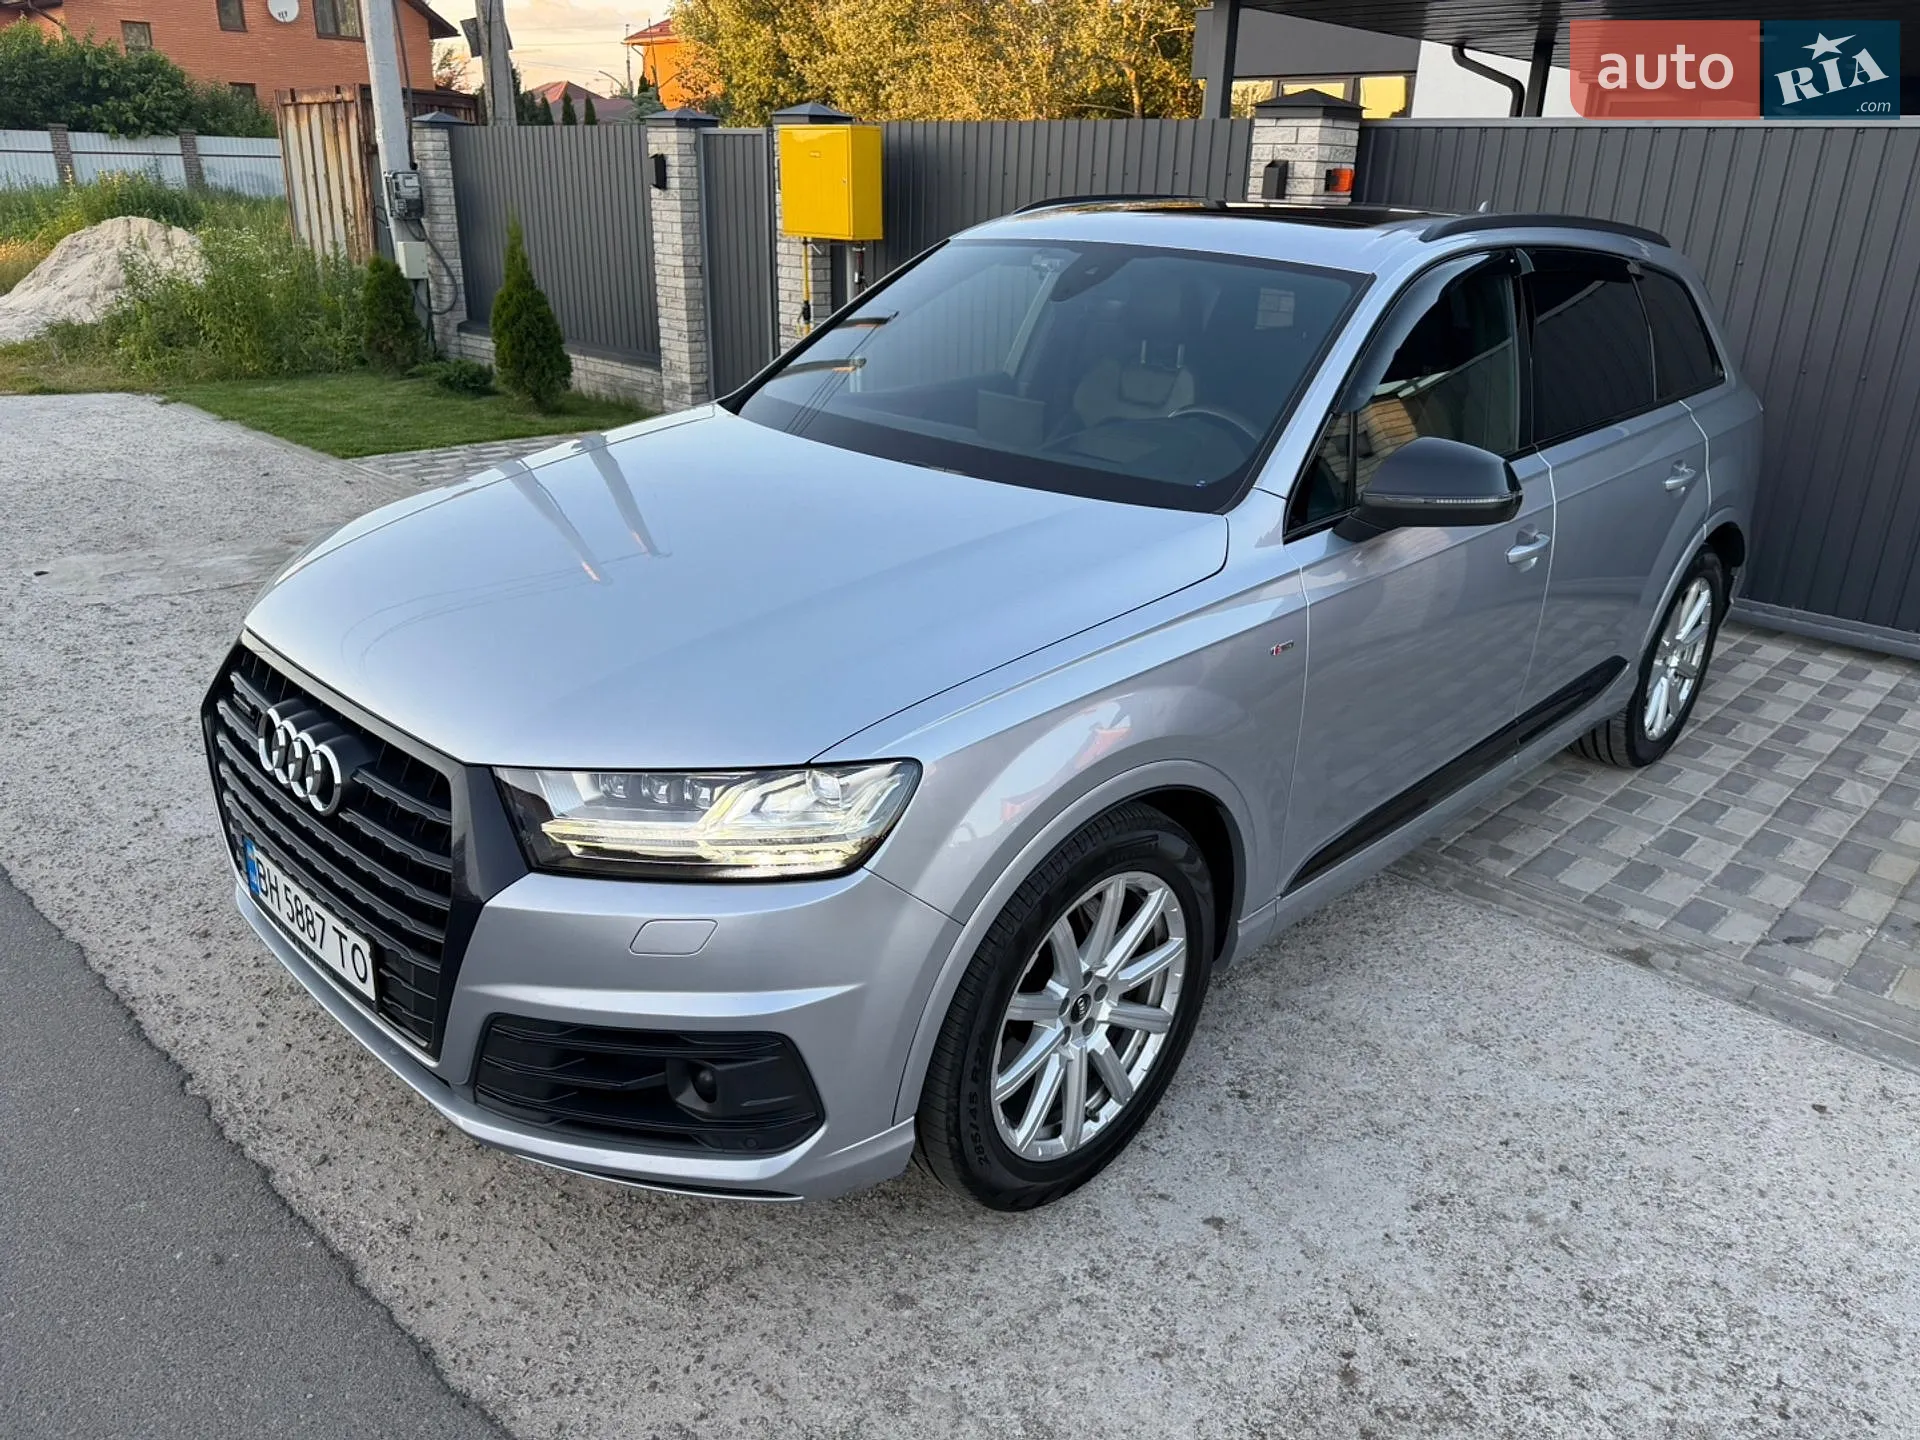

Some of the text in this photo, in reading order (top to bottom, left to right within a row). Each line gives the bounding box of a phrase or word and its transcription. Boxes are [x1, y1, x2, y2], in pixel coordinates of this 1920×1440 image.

[256, 858, 281, 912] BH
[283, 884, 326, 950] 5887
[332, 925, 368, 984] TO
